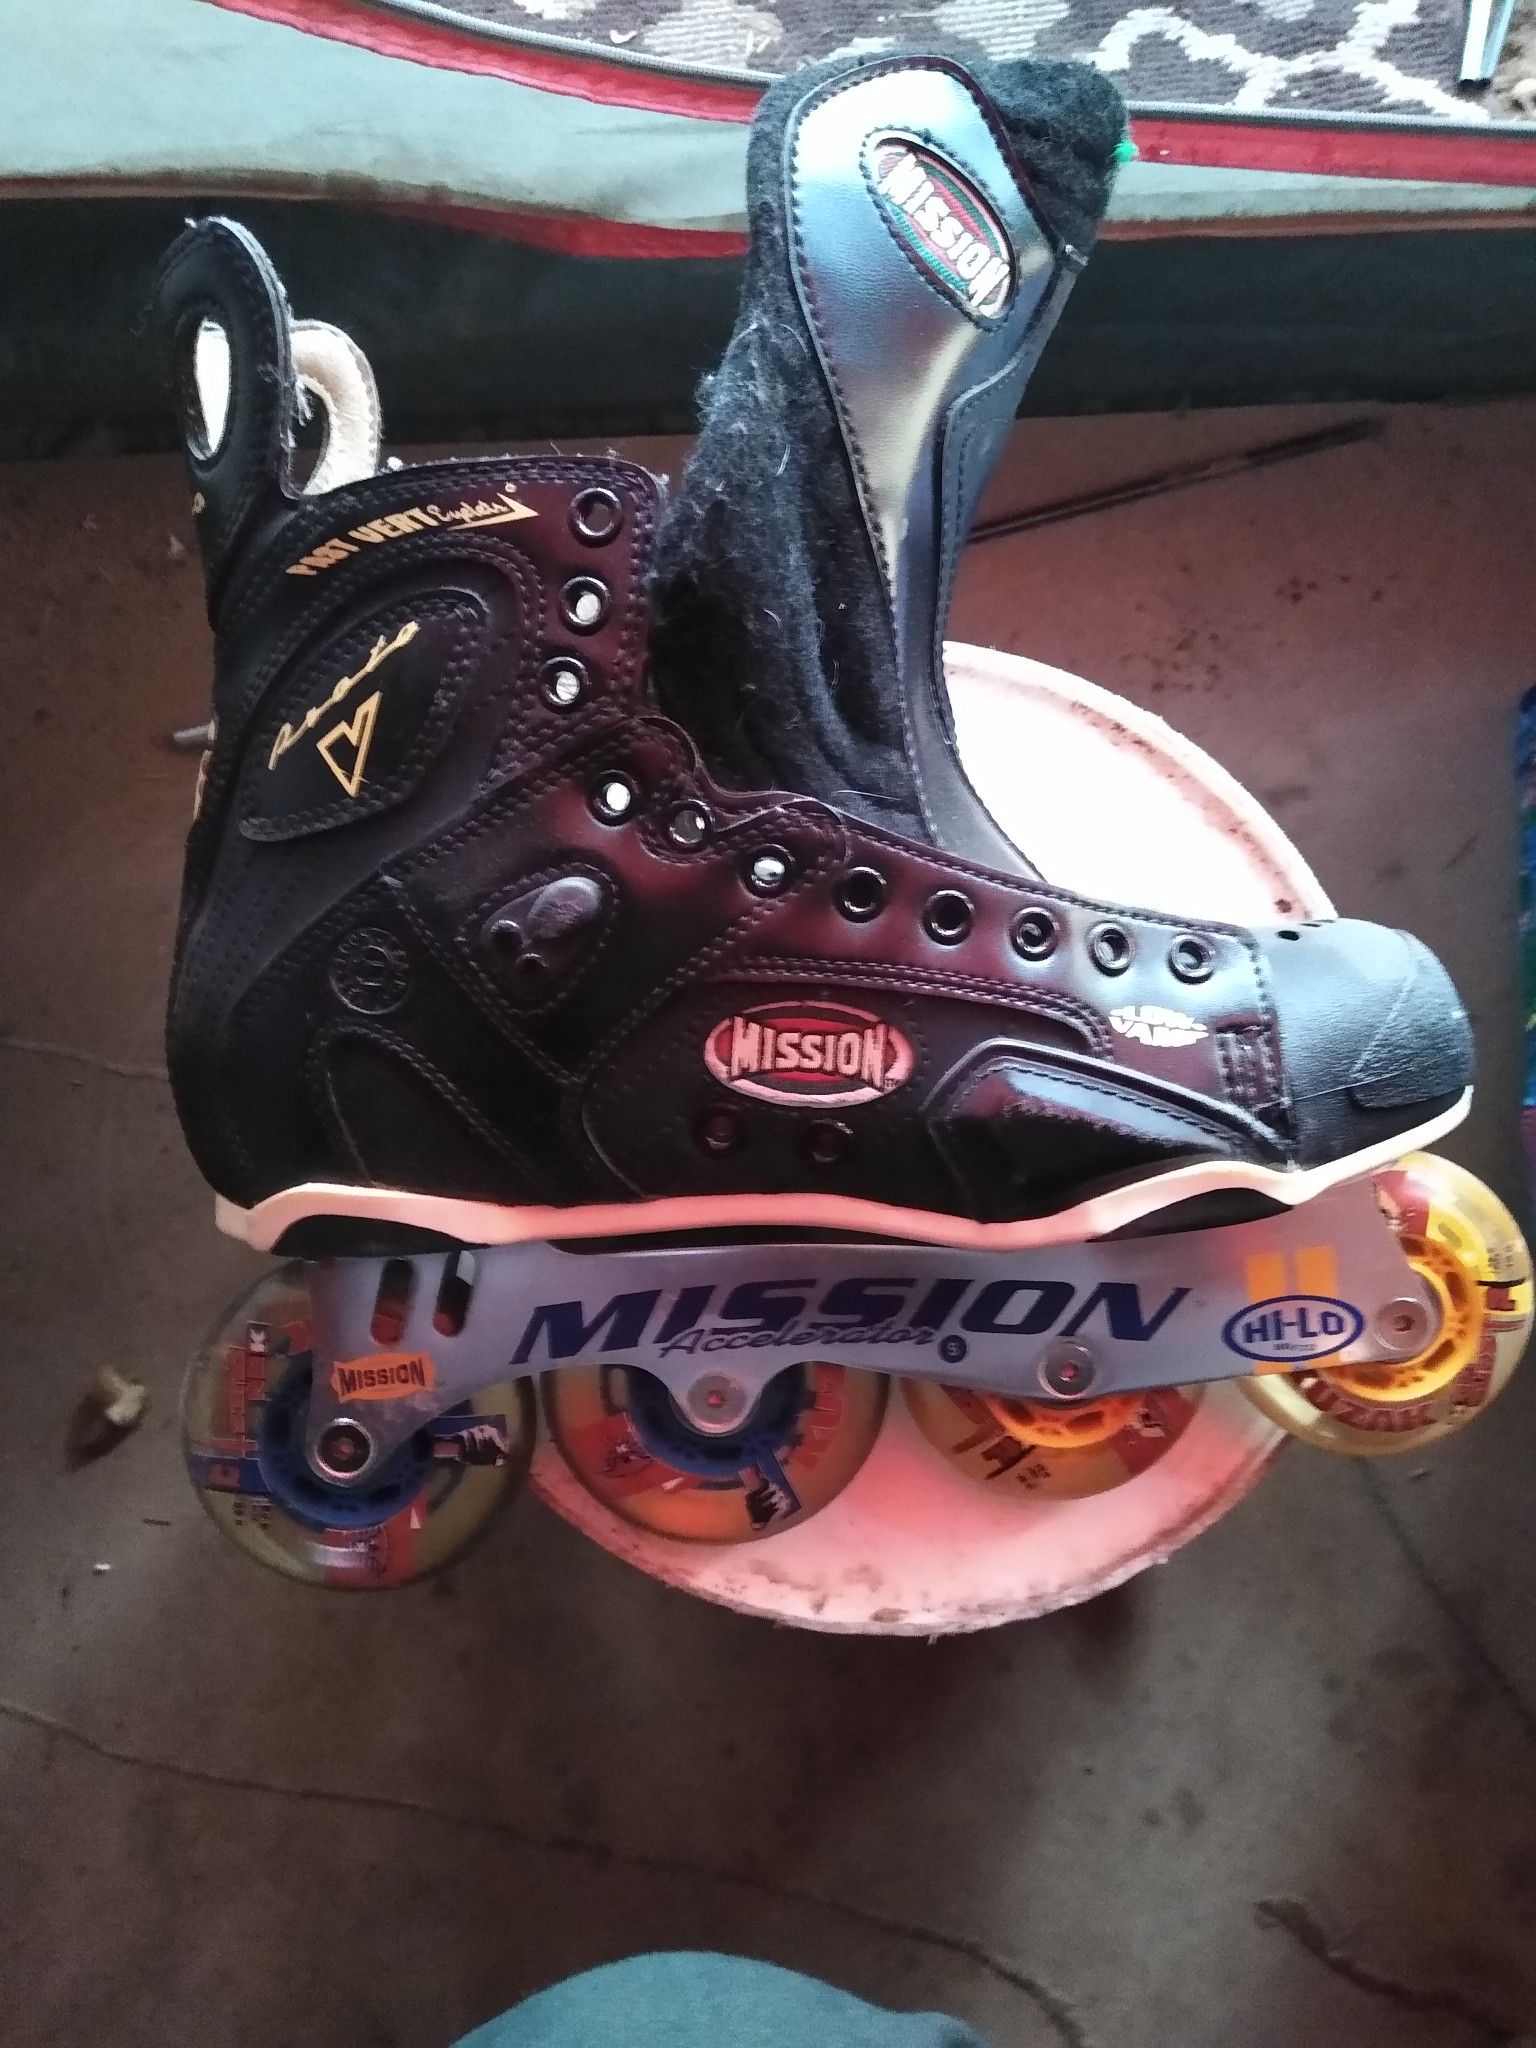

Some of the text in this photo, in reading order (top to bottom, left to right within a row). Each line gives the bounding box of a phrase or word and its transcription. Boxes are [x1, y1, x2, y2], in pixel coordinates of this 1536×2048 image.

[877, 152, 1011, 307] MISSION
[348, 506, 440, 544] VERT
[729, 1014, 889, 1091] MISSION
[508, 1277, 1194, 1366] MISSION
[657, 1315, 937, 1359] Accelerator
[1242, 1305, 1346, 1344] HI-LO
[336, 1356, 427, 1397] MISSION
